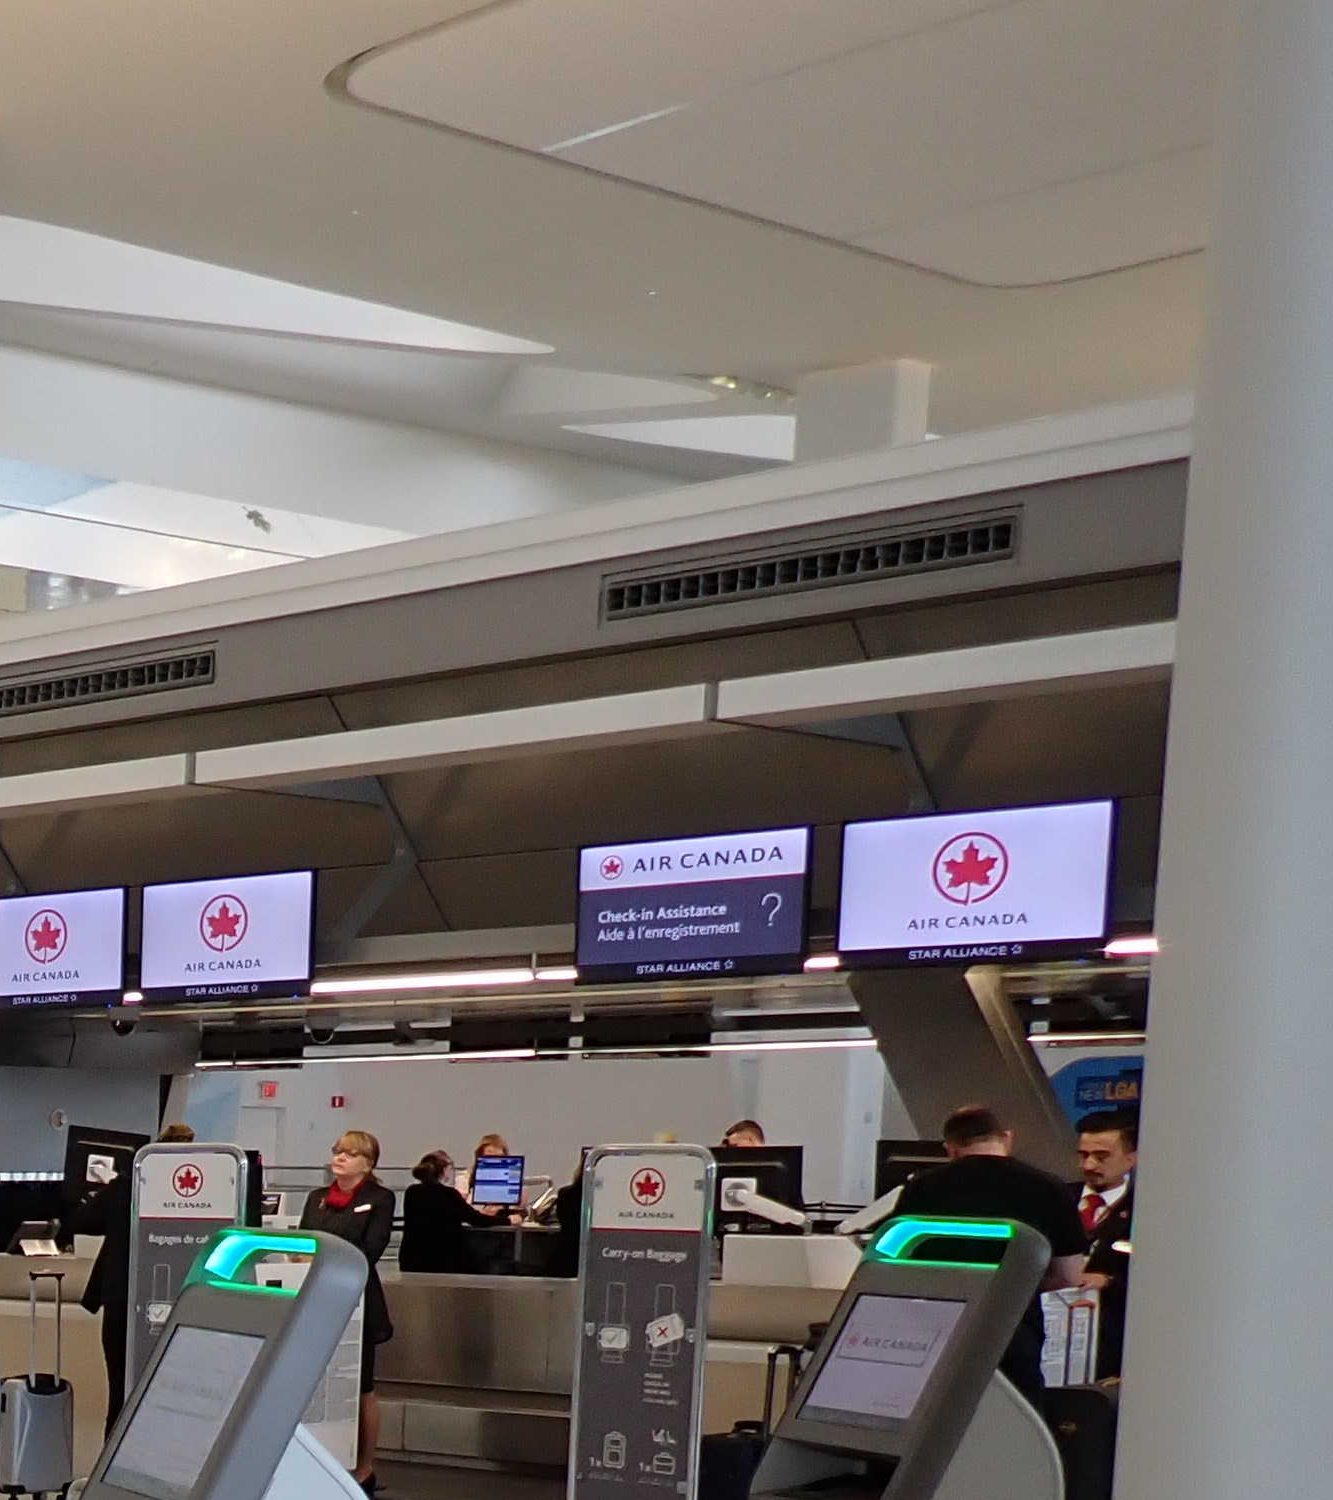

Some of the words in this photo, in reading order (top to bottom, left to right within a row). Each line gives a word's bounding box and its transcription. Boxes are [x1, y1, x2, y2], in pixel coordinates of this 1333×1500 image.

[633, 857, 672, 873] AIR
[679, 846, 783, 868] CANADA
[597, 907, 654, 923] Check-in
[656, 904, 727, 919] Assistance
[907, 918, 939, 930] AIR
[945, 912, 1028, 929] CANADA
[597, 928, 625, 942] Aide
[626, 925, 635, 940] à
[908, 949, 941, 960] STAR
[943, 946, 1008, 958] ALLIANCE
[184, 963, 205, 972] AIR
[208, 958, 262, 971] CANADA
[636, 963, 665, 975] STAR
[666, 960, 720, 972] ALLIANCE
[11, 973, 30, 982] AIR
[32, 970, 79, 981] CANADA
[185, 987, 206, 997] STAR
[207, 985, 249, 995] ALLIANCE
[12, 997, 31, 1005] STAR
[602, 1247, 645, 1261] Carry-on
